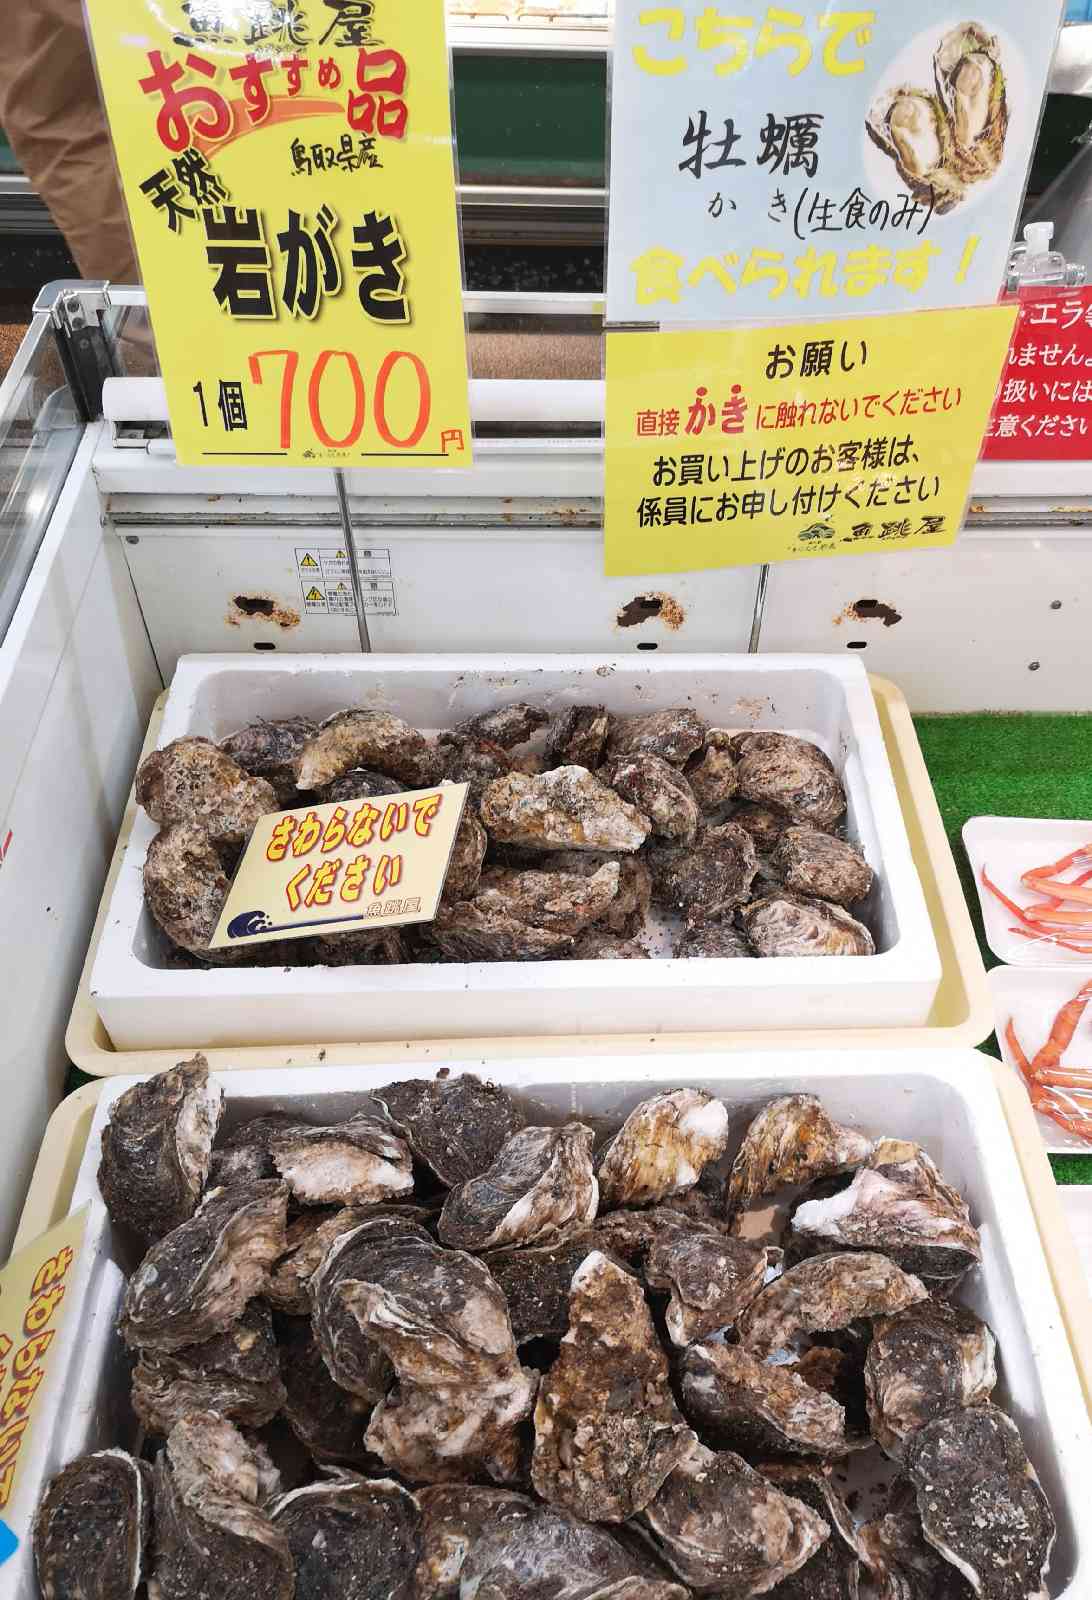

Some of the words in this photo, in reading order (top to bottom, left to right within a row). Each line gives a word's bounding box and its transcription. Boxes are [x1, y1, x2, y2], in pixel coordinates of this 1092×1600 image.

[632, 8, 875, 76] こちらで
[138, 48, 407, 152] おすすめ品
[291, 132, 383, 176] 鳥取県産
[678, 110, 824, 179] 牡蠣
[139, 148, 228, 232] 天然
[203, 205, 409, 322] 岩がき
[765, 340, 868, 379] お願い
[652, 434, 919, 488] お買い上げのお客様は、
[637, 475, 940, 528] 係員にお申し付けください
[266, 793, 443, 862] さわらないで
[285, 855, 402, 912] ください
